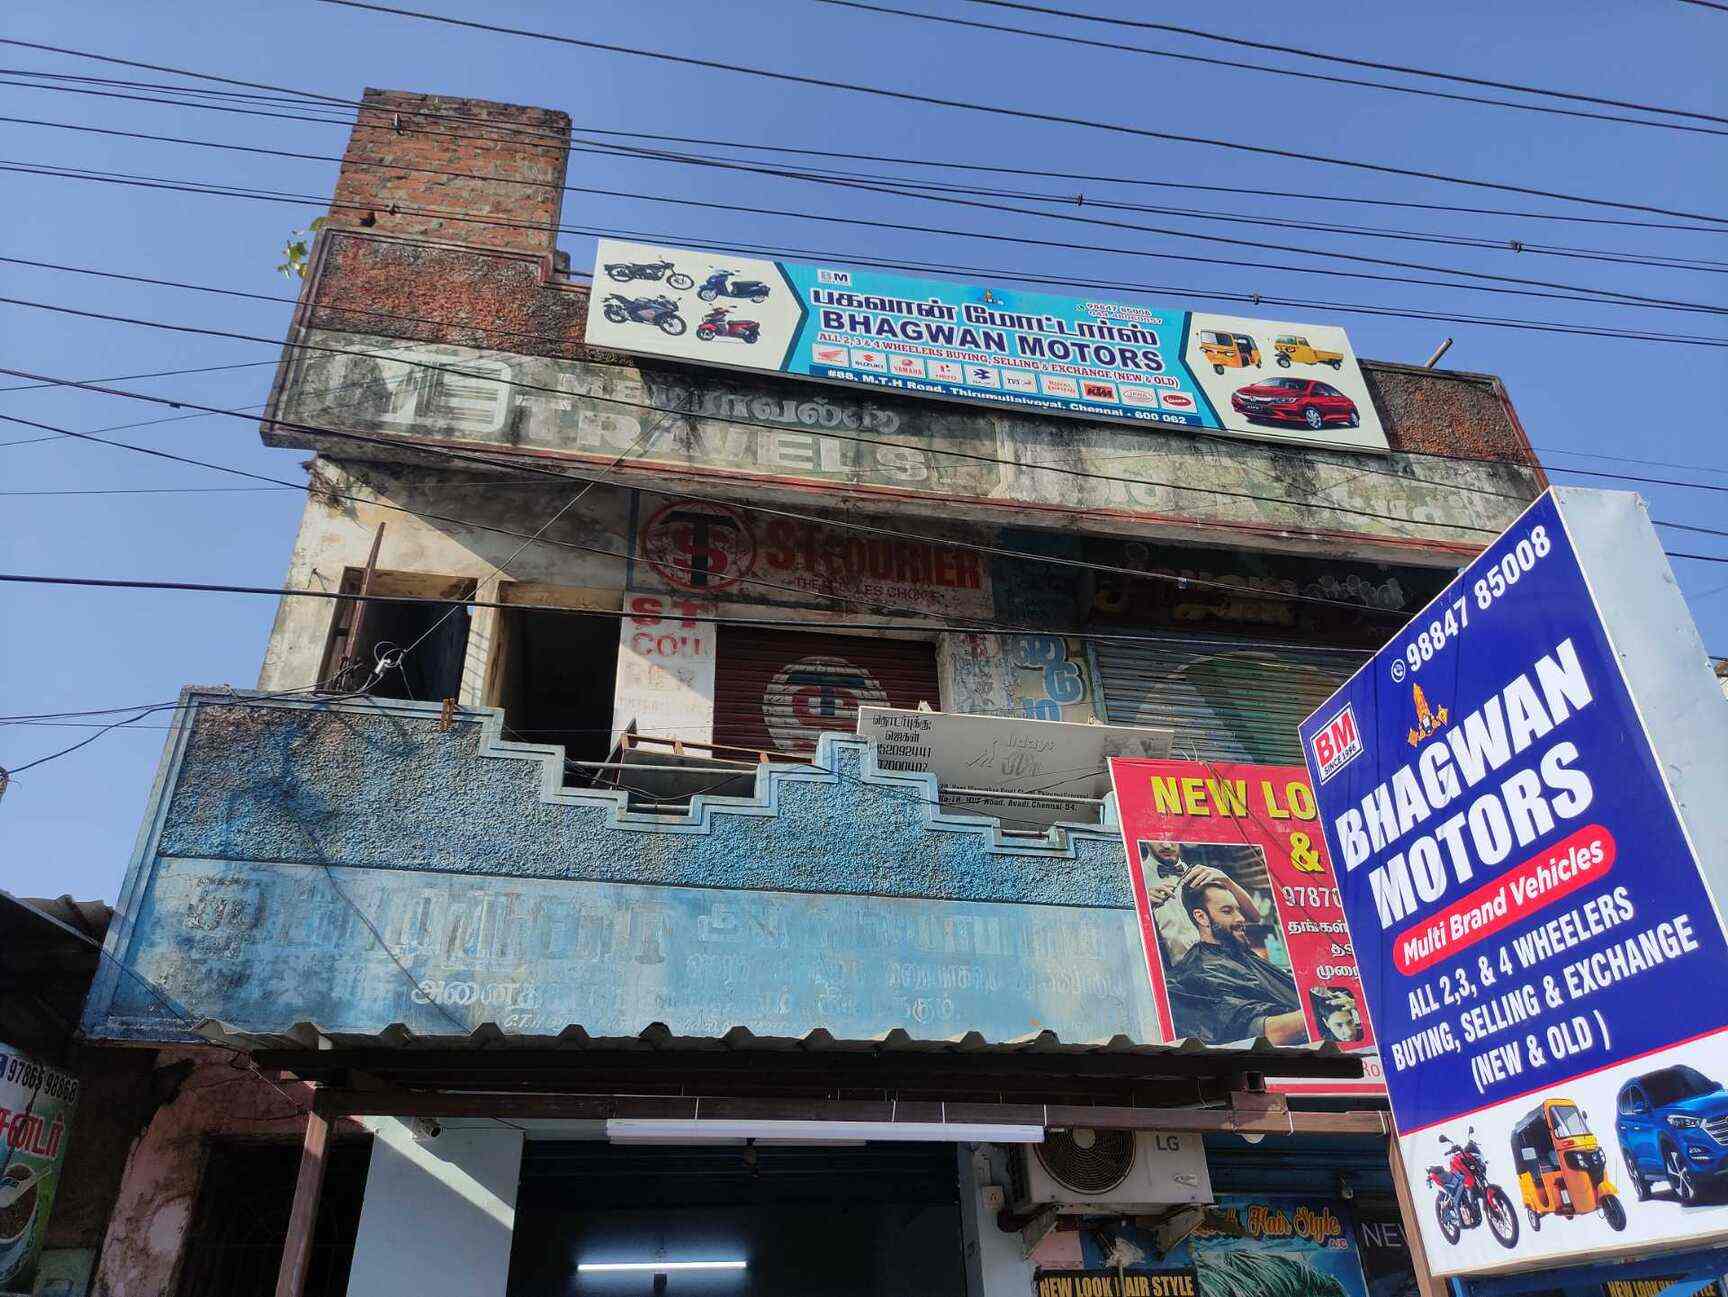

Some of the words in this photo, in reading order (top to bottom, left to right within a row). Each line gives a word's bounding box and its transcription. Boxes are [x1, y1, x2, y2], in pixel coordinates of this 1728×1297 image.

[813, 289, 956, 320] பகவான்
[964, 303, 1159, 346] மோட்டார்ஸ்
[823, 310, 1007, 353] BHAGWAN
[1018, 335, 1163, 371] MOTORS
[819, 333, 839, 343] ALL
[883, 341, 944, 357] WHEELERS
[946, 350, 992, 365] BUYING,
[993, 355, 1039, 369] SELLING
[1052, 363, 1112, 379] EXCHANGE
[1114, 369, 1143, 383] (NEW
[1154, 375, 1179, 389] OLD)
[1070, 402, 1123, 417] Chennai
[1135, 410, 1158, 421] 600
[1405, 597, 1469, 672] 98847
[1474, 524, 1552, 610] 85008
[1315, 712, 1355, 767] BM
[1324, 754, 1342, 775] SINCE
[1335, 637, 1594, 872] BHAGWAN
[1150, 776, 1248, 819] NEW
[1288, 831, 1327, 874] &
[1368, 740, 1594, 930] MOTORS
[1402, 920, 1447, 966] Multi
[1450, 890, 1507, 940] Brand
[1509, 839, 1605, 907] Vehicles
[1408, 982, 1440, 1021] ALL
[1478, 955, 1497, 985] &
[1499, 946, 1514, 976] 4
[1513, 886, 1635, 969] WHEELERS
[1391, 1019, 1461, 1072] BUYING,
[1460, 984, 1541, 1043] SELLING
[1542, 974, 1564, 1008] &
[1563, 913, 1699, 1000] EXCHANGE
[1470, 1043, 1523, 1095] (NEW
[1526, 1034, 1547, 1068] &
[1155, 1134, 1181, 1152] LG
[1248, 1204, 1292, 1237] Hair
[1294, 1205, 1342, 1243] Style
[1039, 1277, 1072, 1297] NEW
[1074, 1276, 1112, 1297] LOOK
[1152, 1275, 1195, 1297] STYLE
